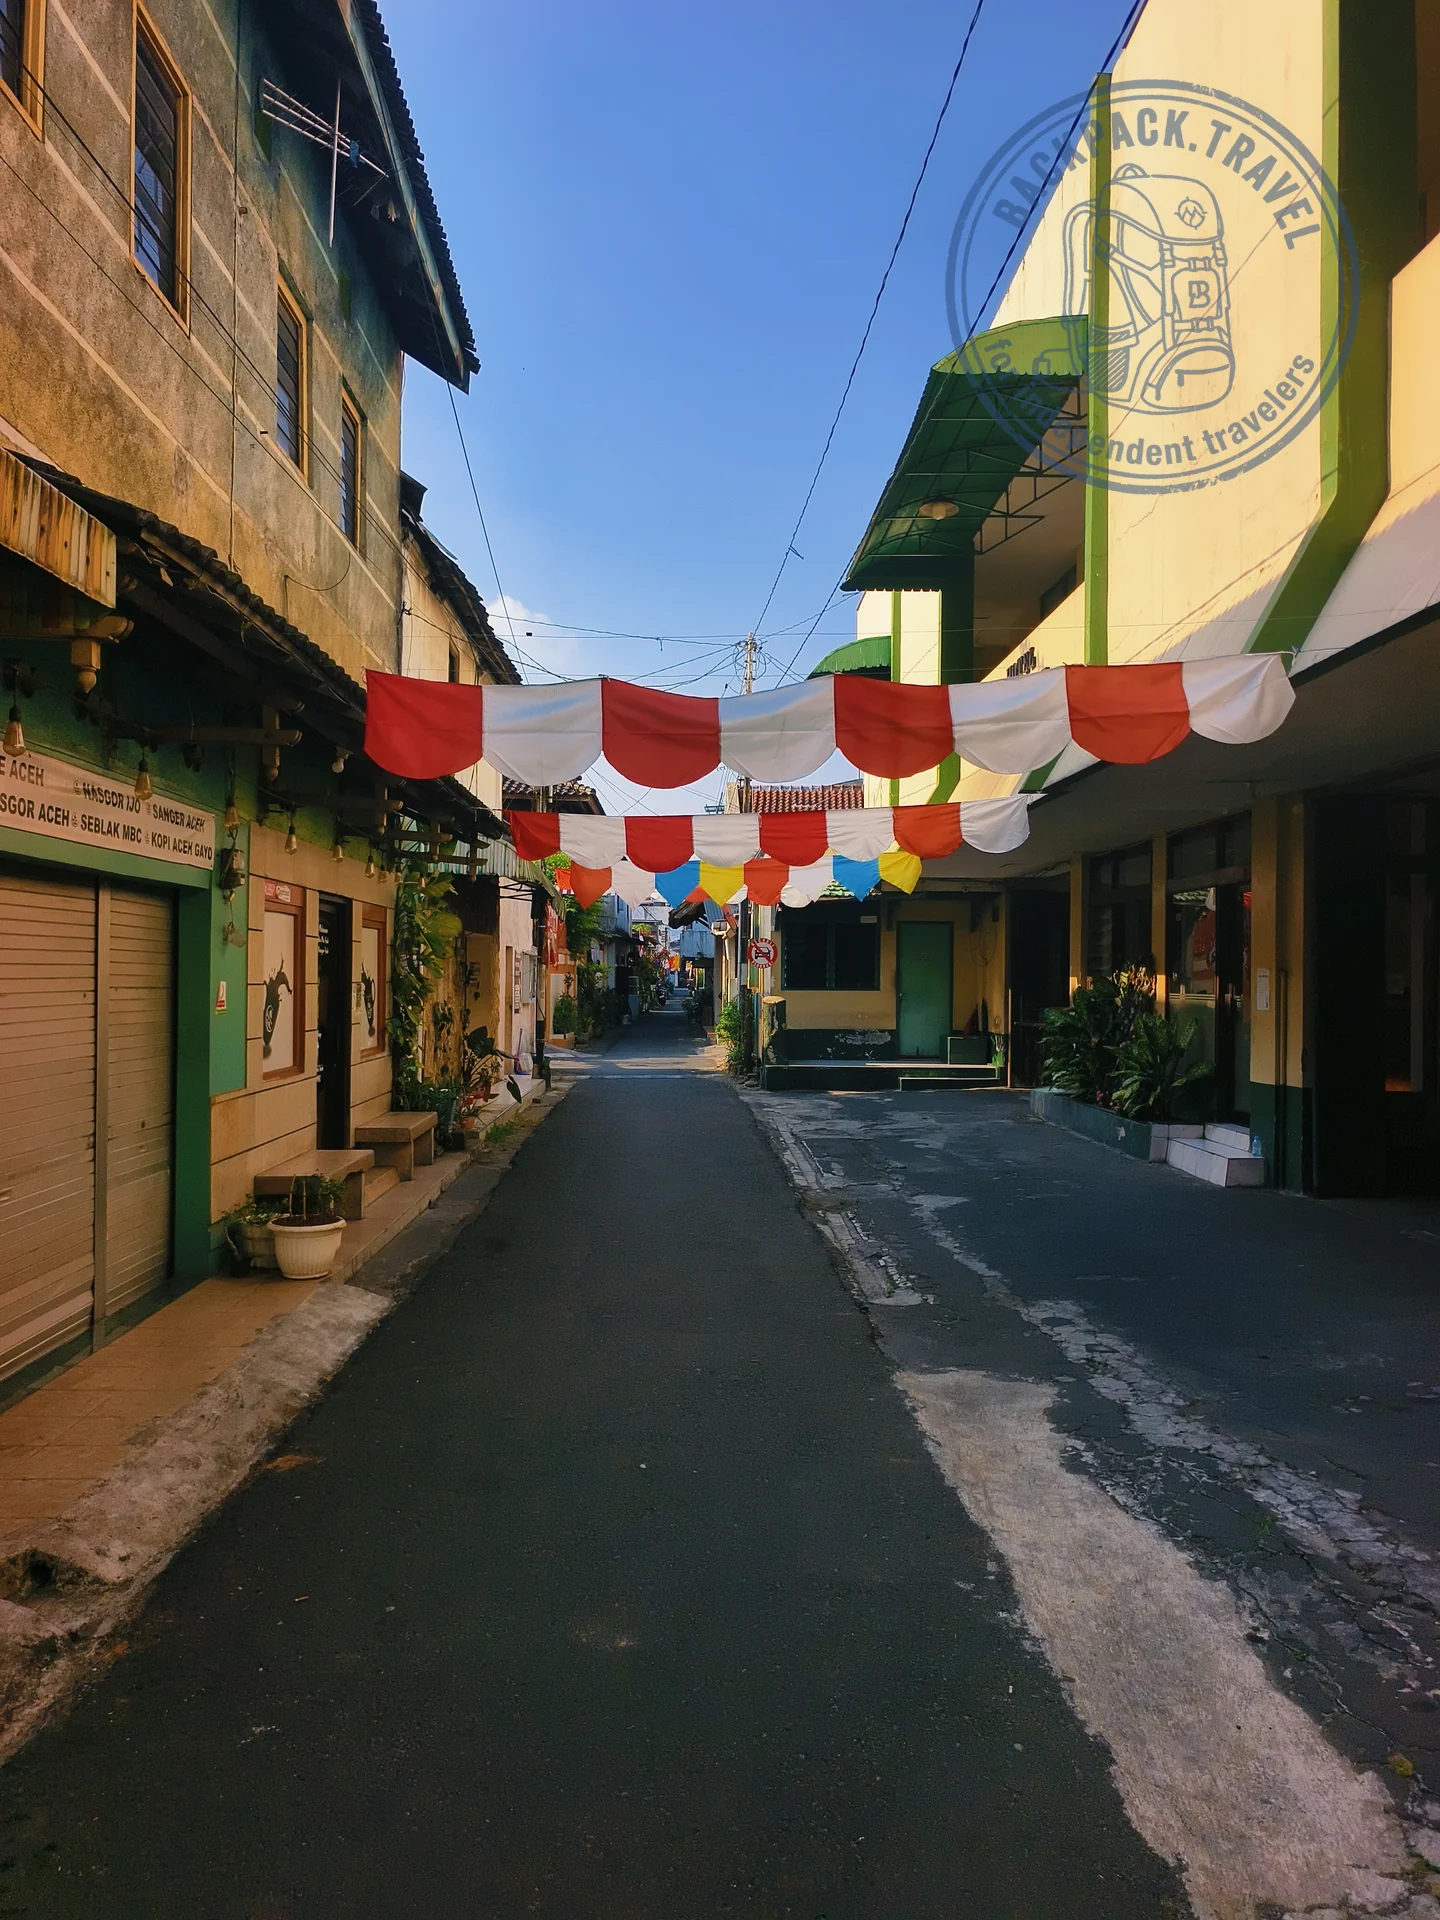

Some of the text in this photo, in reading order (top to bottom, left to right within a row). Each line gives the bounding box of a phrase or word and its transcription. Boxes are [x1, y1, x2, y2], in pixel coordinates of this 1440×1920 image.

[9, 759, 44, 787] ACEH
[82, 782, 124, 809] NASGOR
[126, 795, 141, 814] IJO
[152, 803, 185, 827] SANGER
[185, 814, 206, 833] ACEH
[38, 803, 70, 827] ACEH
[80, 814, 120, 839] SEBLAK
[122, 824, 142, 844] MBC
[151, 831, 171, 851] KOPI
[172, 837, 193, 855] ACEH
[194, 842, 213, 861] GAYO
